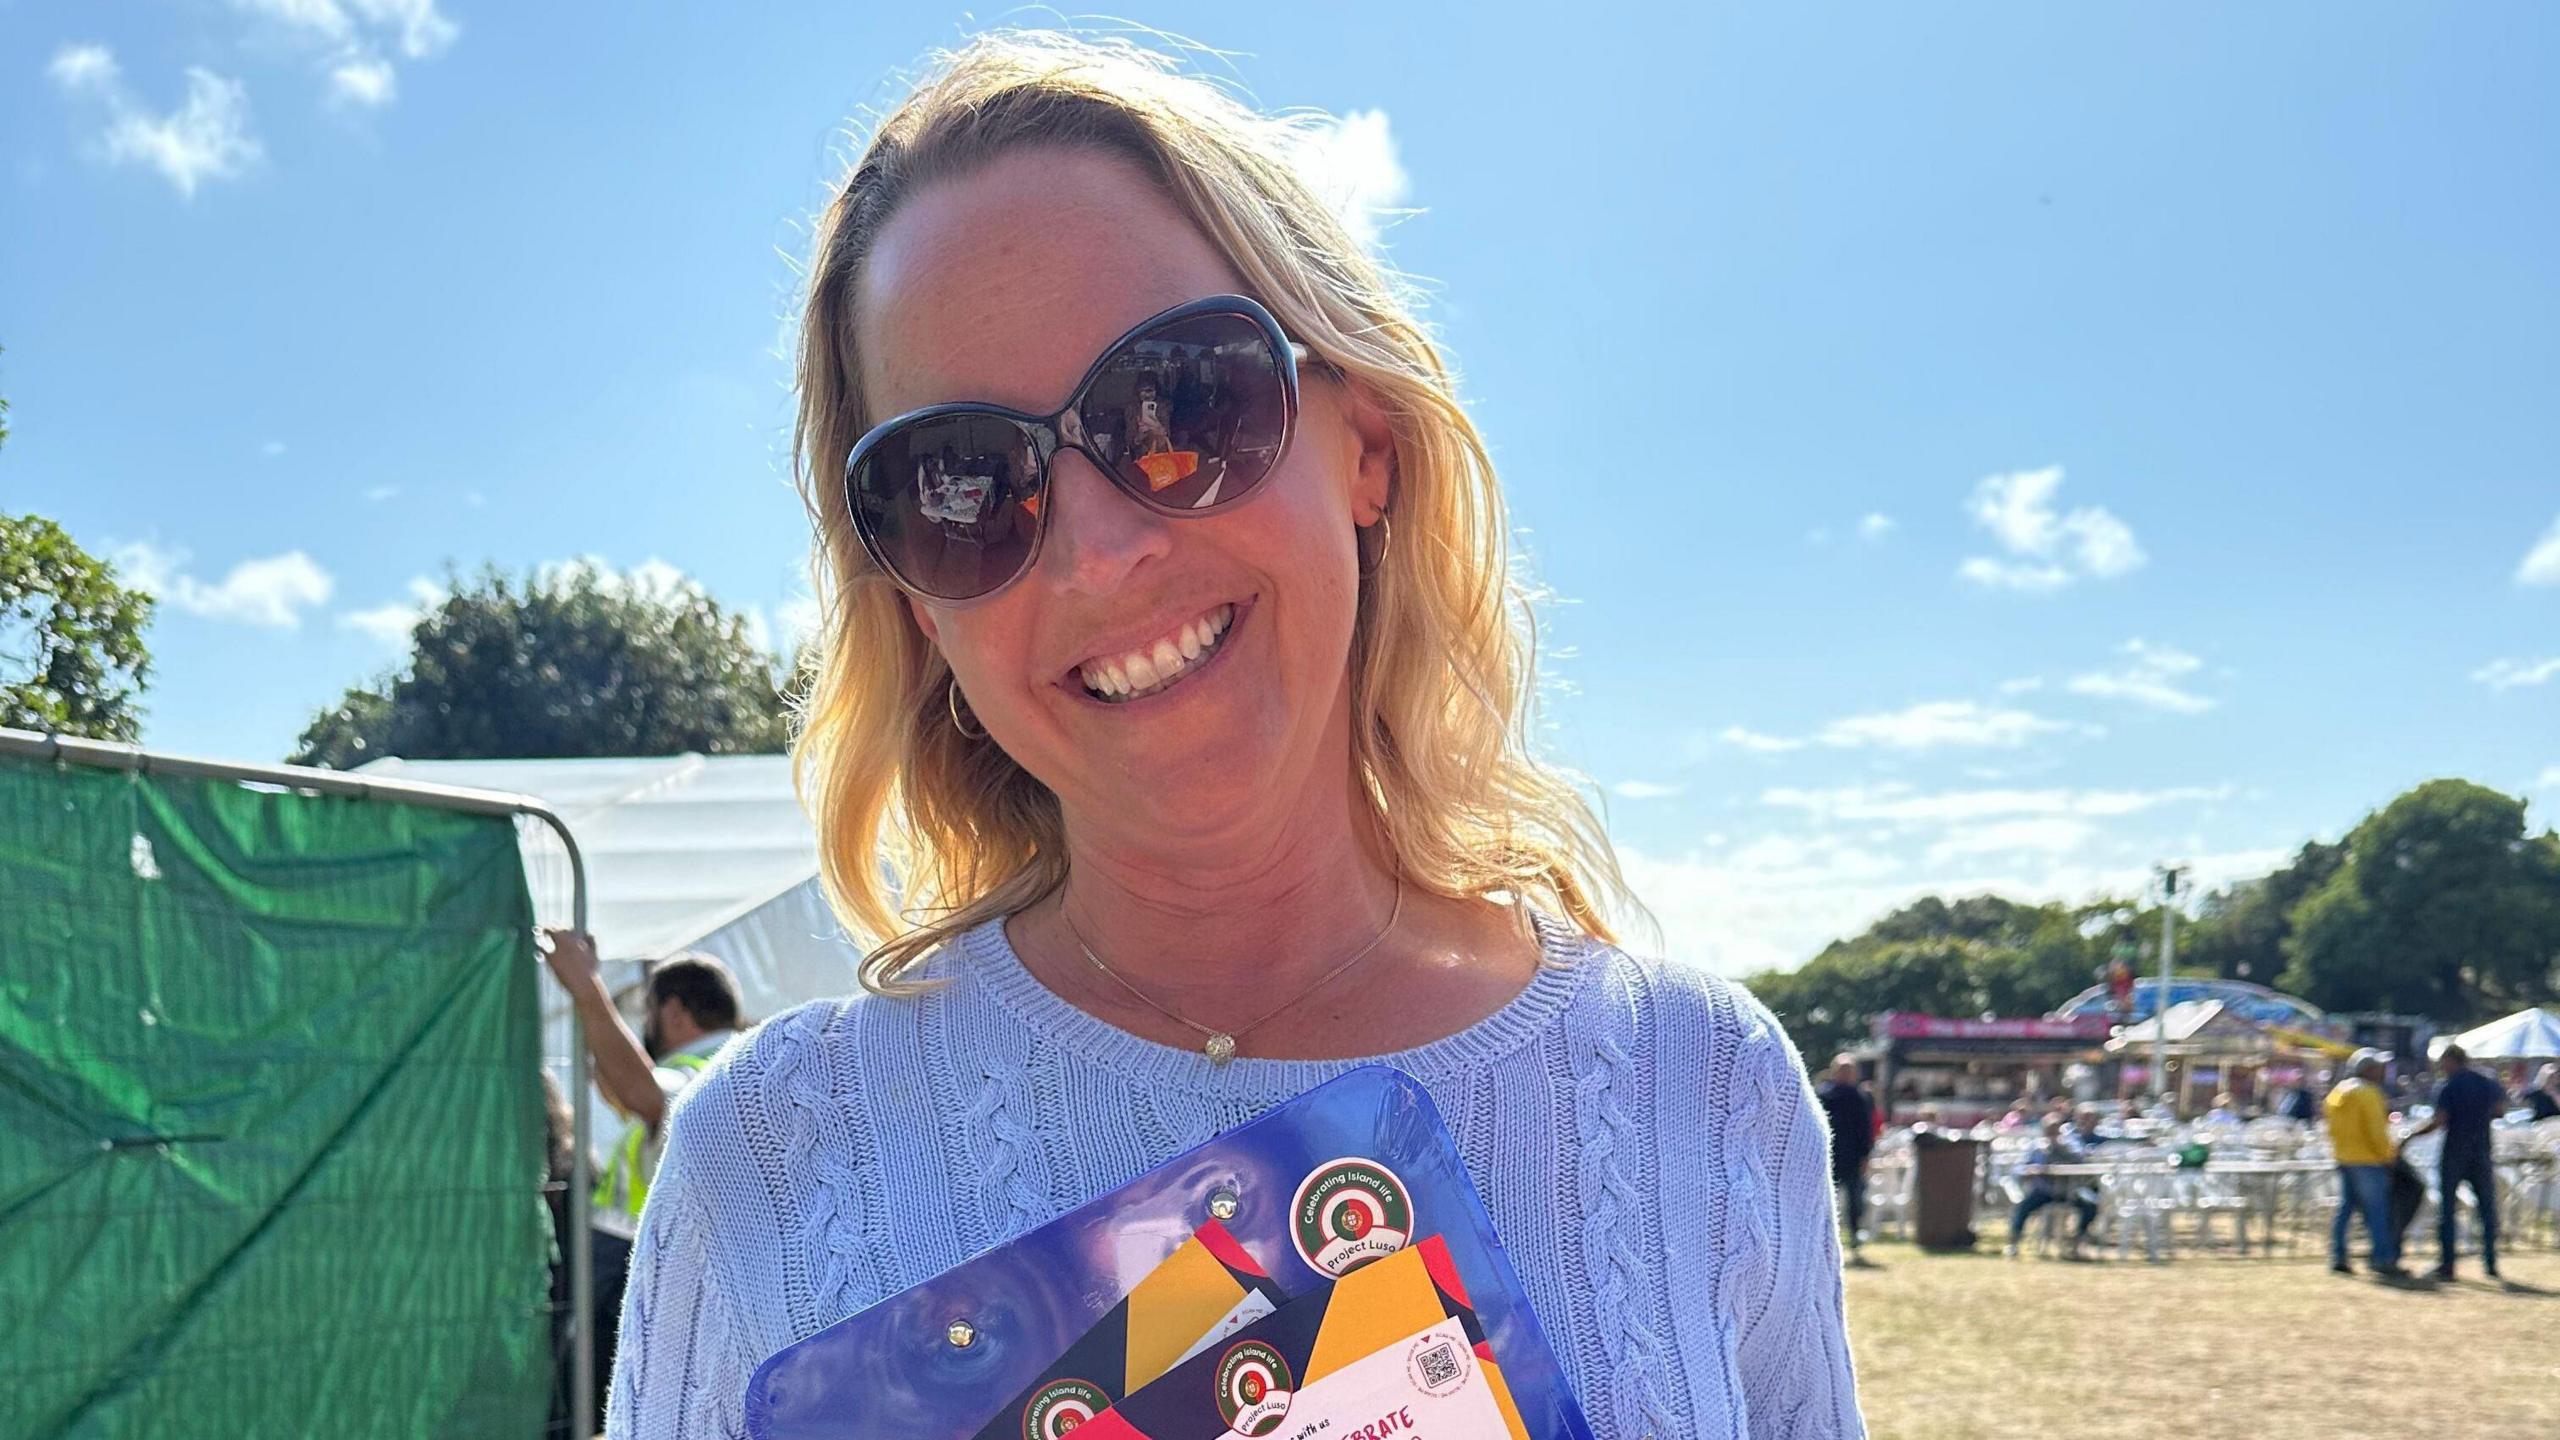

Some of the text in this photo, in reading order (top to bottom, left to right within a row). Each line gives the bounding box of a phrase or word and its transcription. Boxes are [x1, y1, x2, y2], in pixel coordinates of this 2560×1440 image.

[1305, 1172, 1393, 1224] Celebrating Island life
[1327, 1240, 1396, 1270] Project Luso
[1221, 1348, 1277, 1398] Celebrating Island life
[1029, 1386, 1092, 1440] elebrating Island life
[1241, 1401, 1286, 1432] Project Luso
[1319, 1419, 1330, 1429] us
